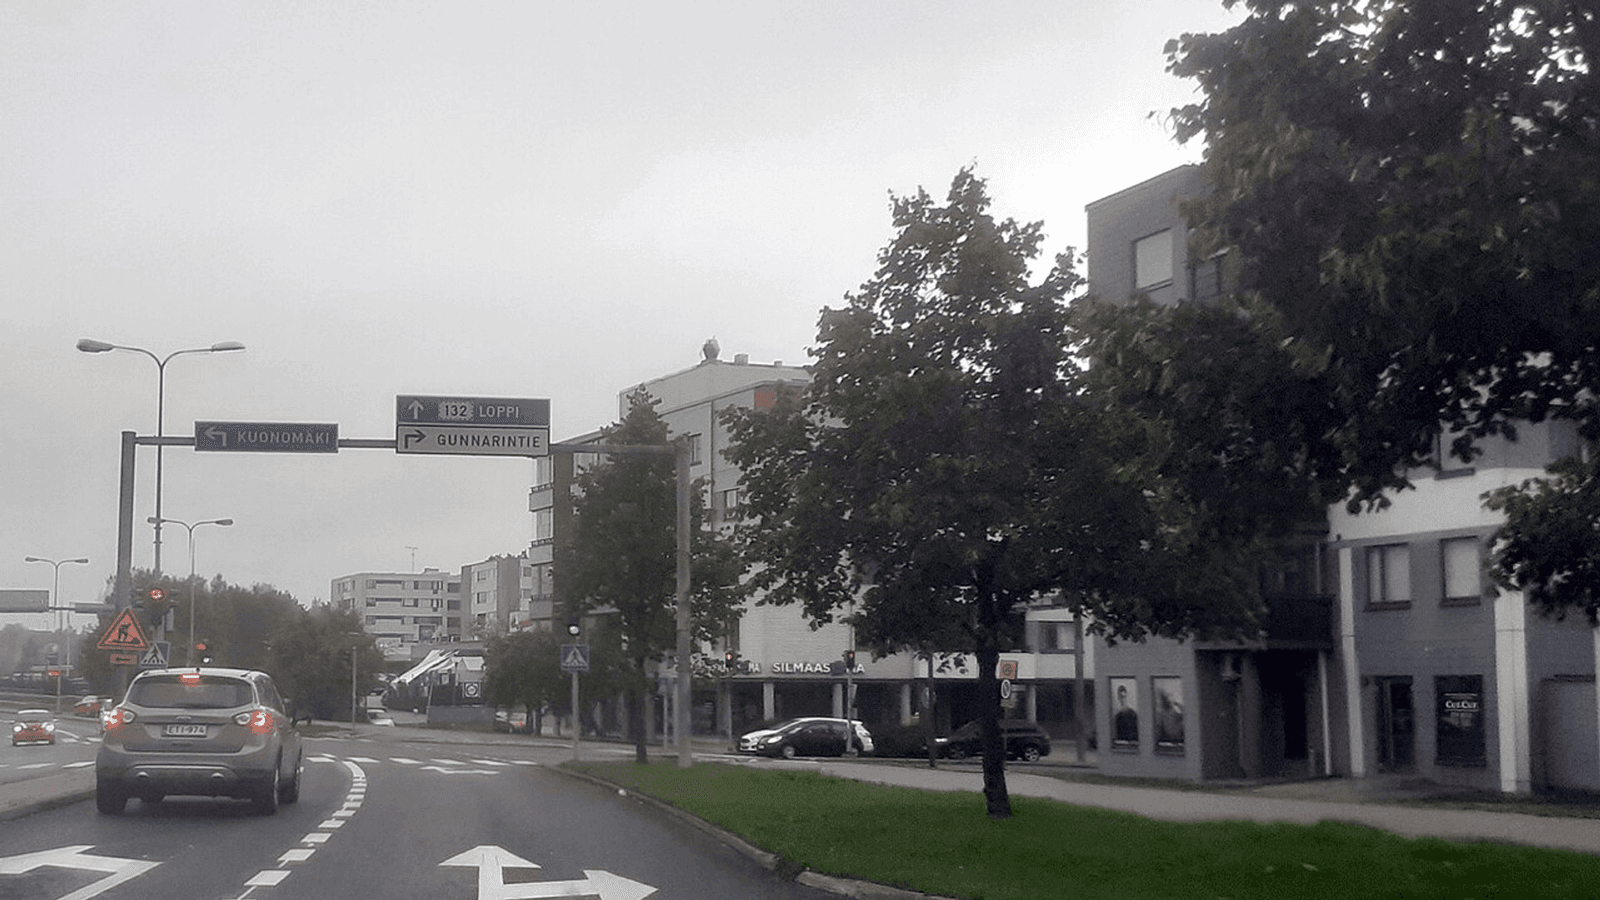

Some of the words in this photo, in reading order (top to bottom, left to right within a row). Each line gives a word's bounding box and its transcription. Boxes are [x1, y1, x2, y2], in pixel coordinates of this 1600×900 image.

[445, 405, 467, 416] 132
[479, 405, 519, 418] LOPPI
[238, 430, 329, 444] KUONOMÄKI
[437, 434, 541, 448] GUNNARINTIE
